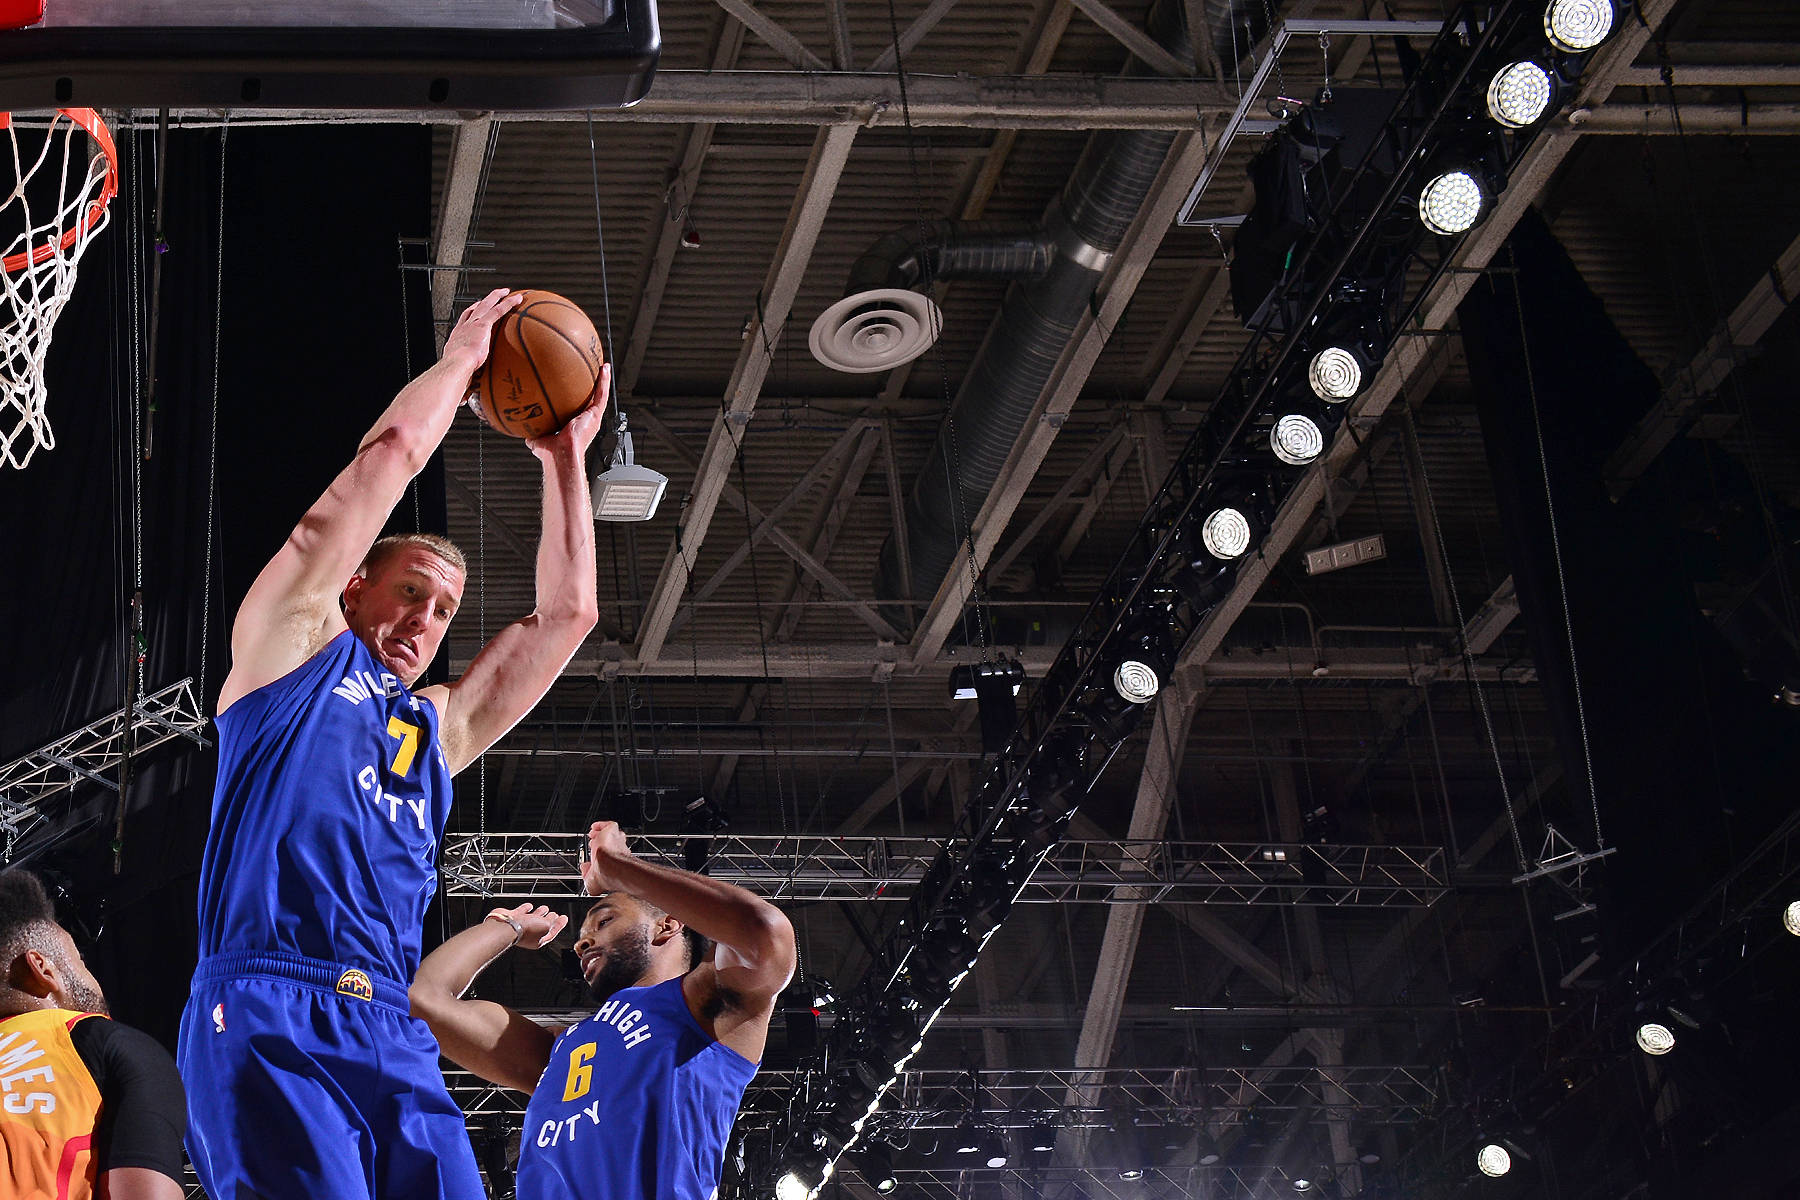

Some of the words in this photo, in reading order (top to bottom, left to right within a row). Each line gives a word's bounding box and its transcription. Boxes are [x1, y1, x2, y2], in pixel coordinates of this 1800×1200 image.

[332, 670, 401, 706] MILE
[387, 715, 424, 778] 7
[358, 765, 426, 830] CITY
[593, 1000, 651, 1050] HIGH
[562, 1041, 597, 1102] 6
[537, 1100, 600, 1148] CITY
